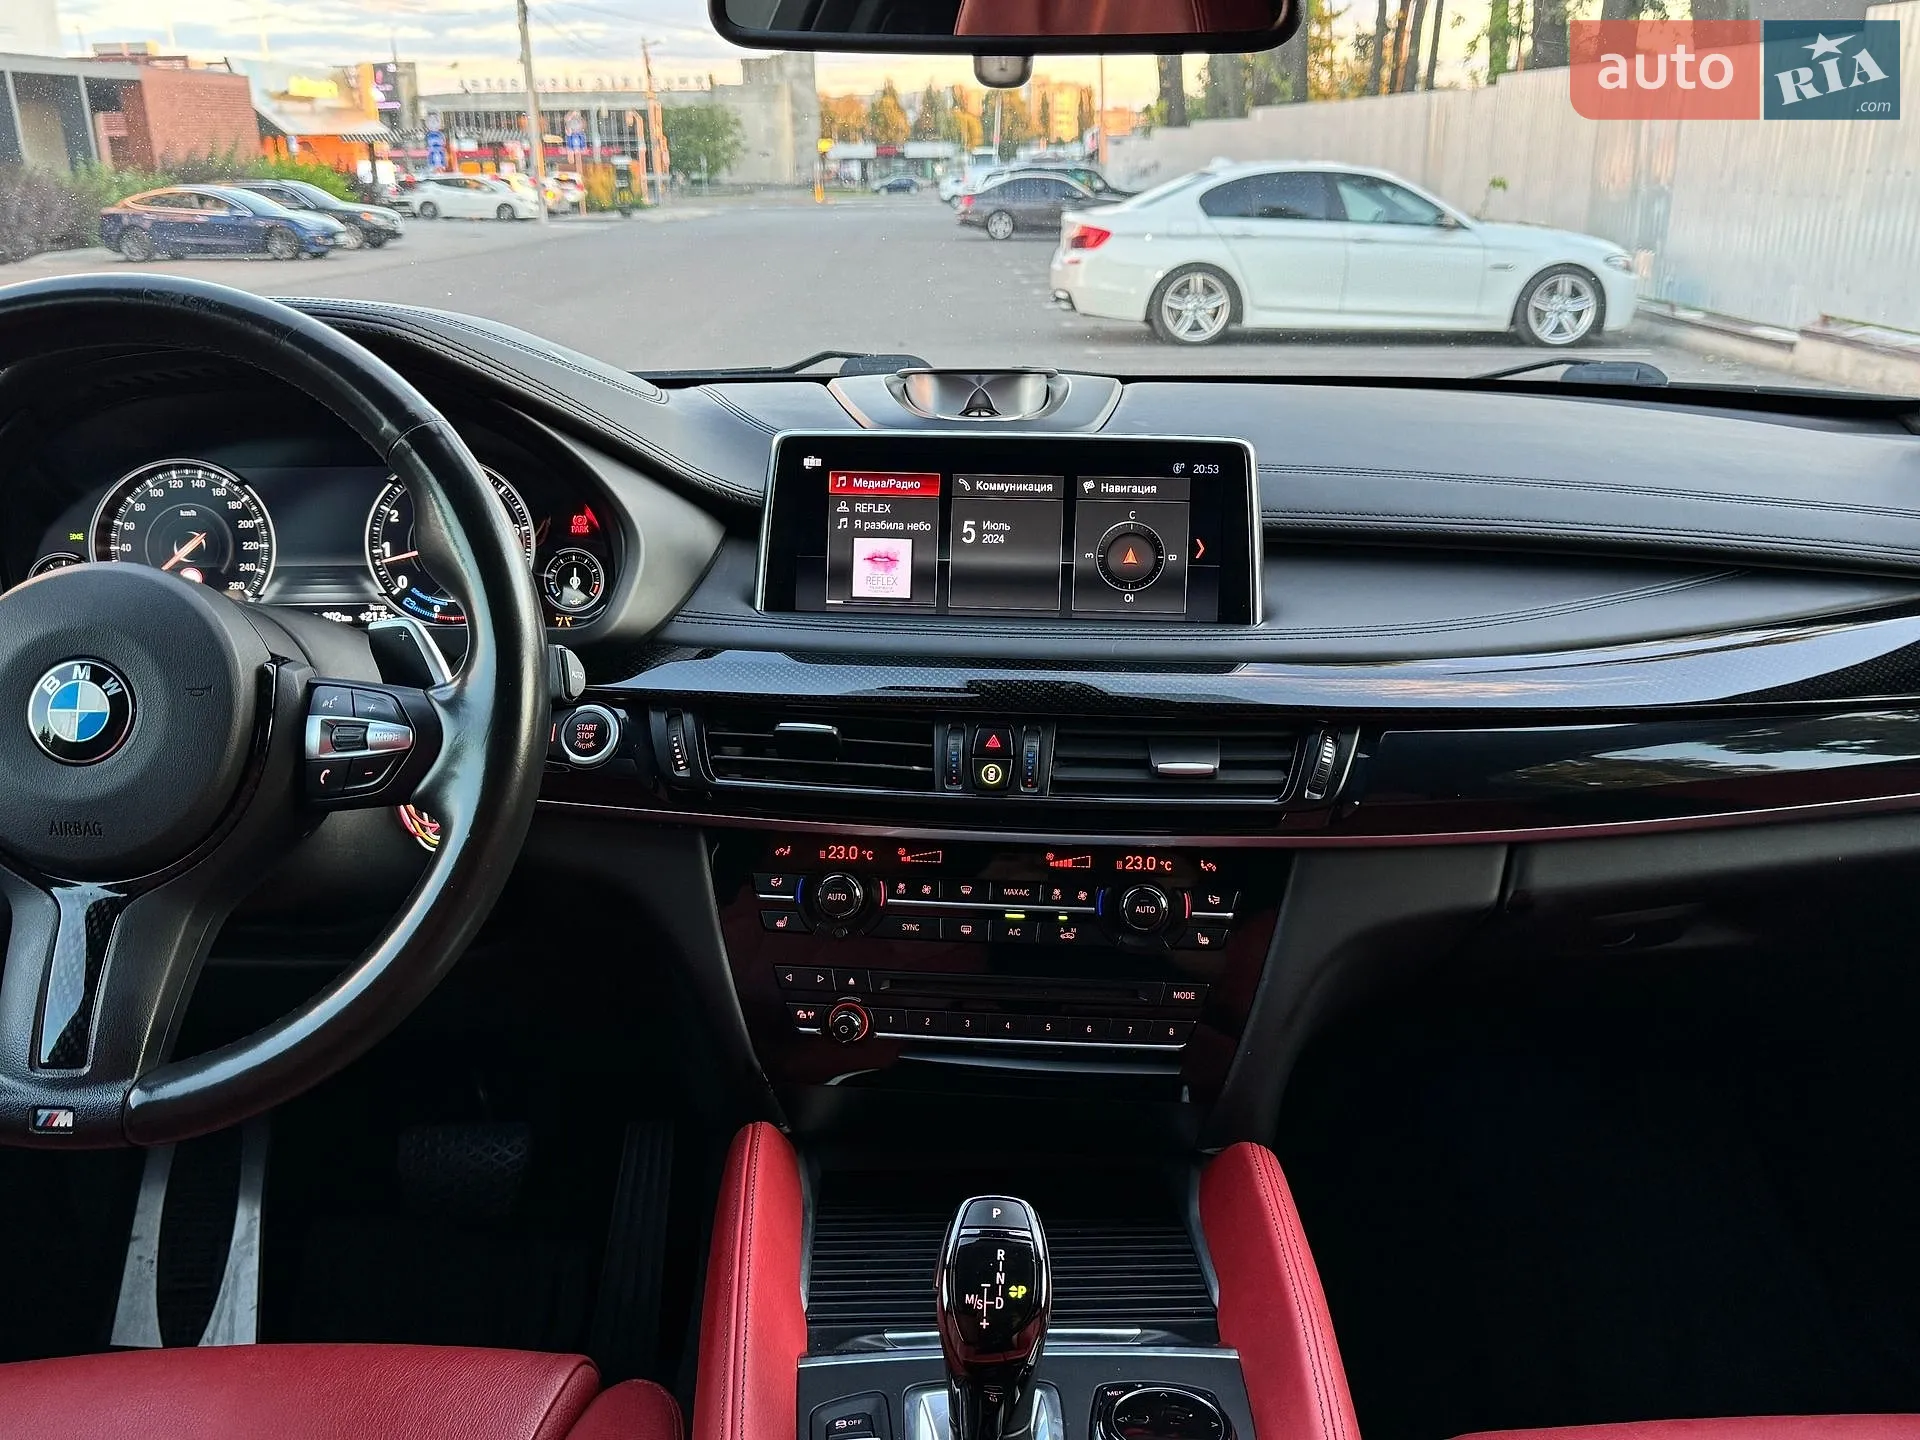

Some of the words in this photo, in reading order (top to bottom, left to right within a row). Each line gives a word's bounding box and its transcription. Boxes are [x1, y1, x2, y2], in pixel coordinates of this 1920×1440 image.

[1193, 464, 1219, 474] 20:53
[168, 479, 183, 489] 120
[191, 479, 206, 489] 140
[853, 478, 921, 489] Медиа/Радио
[976, 481, 1053, 493] Коммуникация
[1101, 483, 1157, 494] Навигация
[149, 488, 164, 498] 100
[211, 487, 227, 497] 160
[134, 503, 146, 512] 80
[227, 501, 242, 510] 180
[855, 503, 891, 513] REFLEX
[179, 508, 197, 517] km/h
[389, 508, 399, 523] 2
[123, 522, 135, 531] 60
[237, 519, 254, 529] 200
[570, 524, 590, 534] PARK
[854, 520, 861, 528] Я
[864, 520, 904, 531] разбила
[907, 521, 931, 531] небо
[962, 520, 976, 543] 5
[982, 520, 1011, 531] Июль
[982, 534, 1004, 544] 2024
[120, 543, 132, 553] 40
[242, 541, 259, 551] 220
[382, 542, 391, 558] 1
[239, 563, 256, 573] 240
[228, 581, 245, 591] 260
[397, 574, 408, 589] 0
[866, 576, 898, 586] REFLEX
[41, 664, 123, 697] BMW
[576, 723, 597, 732] START
[576, 732, 595, 740] STOP
[574, 739, 596, 750] ENGINE
[50, 820, 103, 837] AIRBAG
[828, 845, 858, 860] 23.0
[1125, 855, 1156, 871] 23.0
[827, 892, 847, 902] AUTO
[1135, 905, 1156, 915] AUTO
[902, 923, 920, 932] SYNC
[1008, 928, 1021, 937] A/C
[1173, 991, 1196, 1001] MODE
[925, 1018, 930, 1026] 2
[965, 1020, 970, 1028] 3
[1005, 1022, 1010, 1030] 4
[1046, 1023, 1051, 1031] 5
[1087, 1025, 1092, 1033] 6
[1169, 1028, 1174, 1036] 8
[992, 1208, 1001, 1218] P
[997, 1249, 1005, 1261] R
[996, 1272, 1005, 1284] N
[1018, 1286, 1027, 1298] P
[965, 1294, 983, 1310] M/S
[995, 1296, 1004, 1310] D
